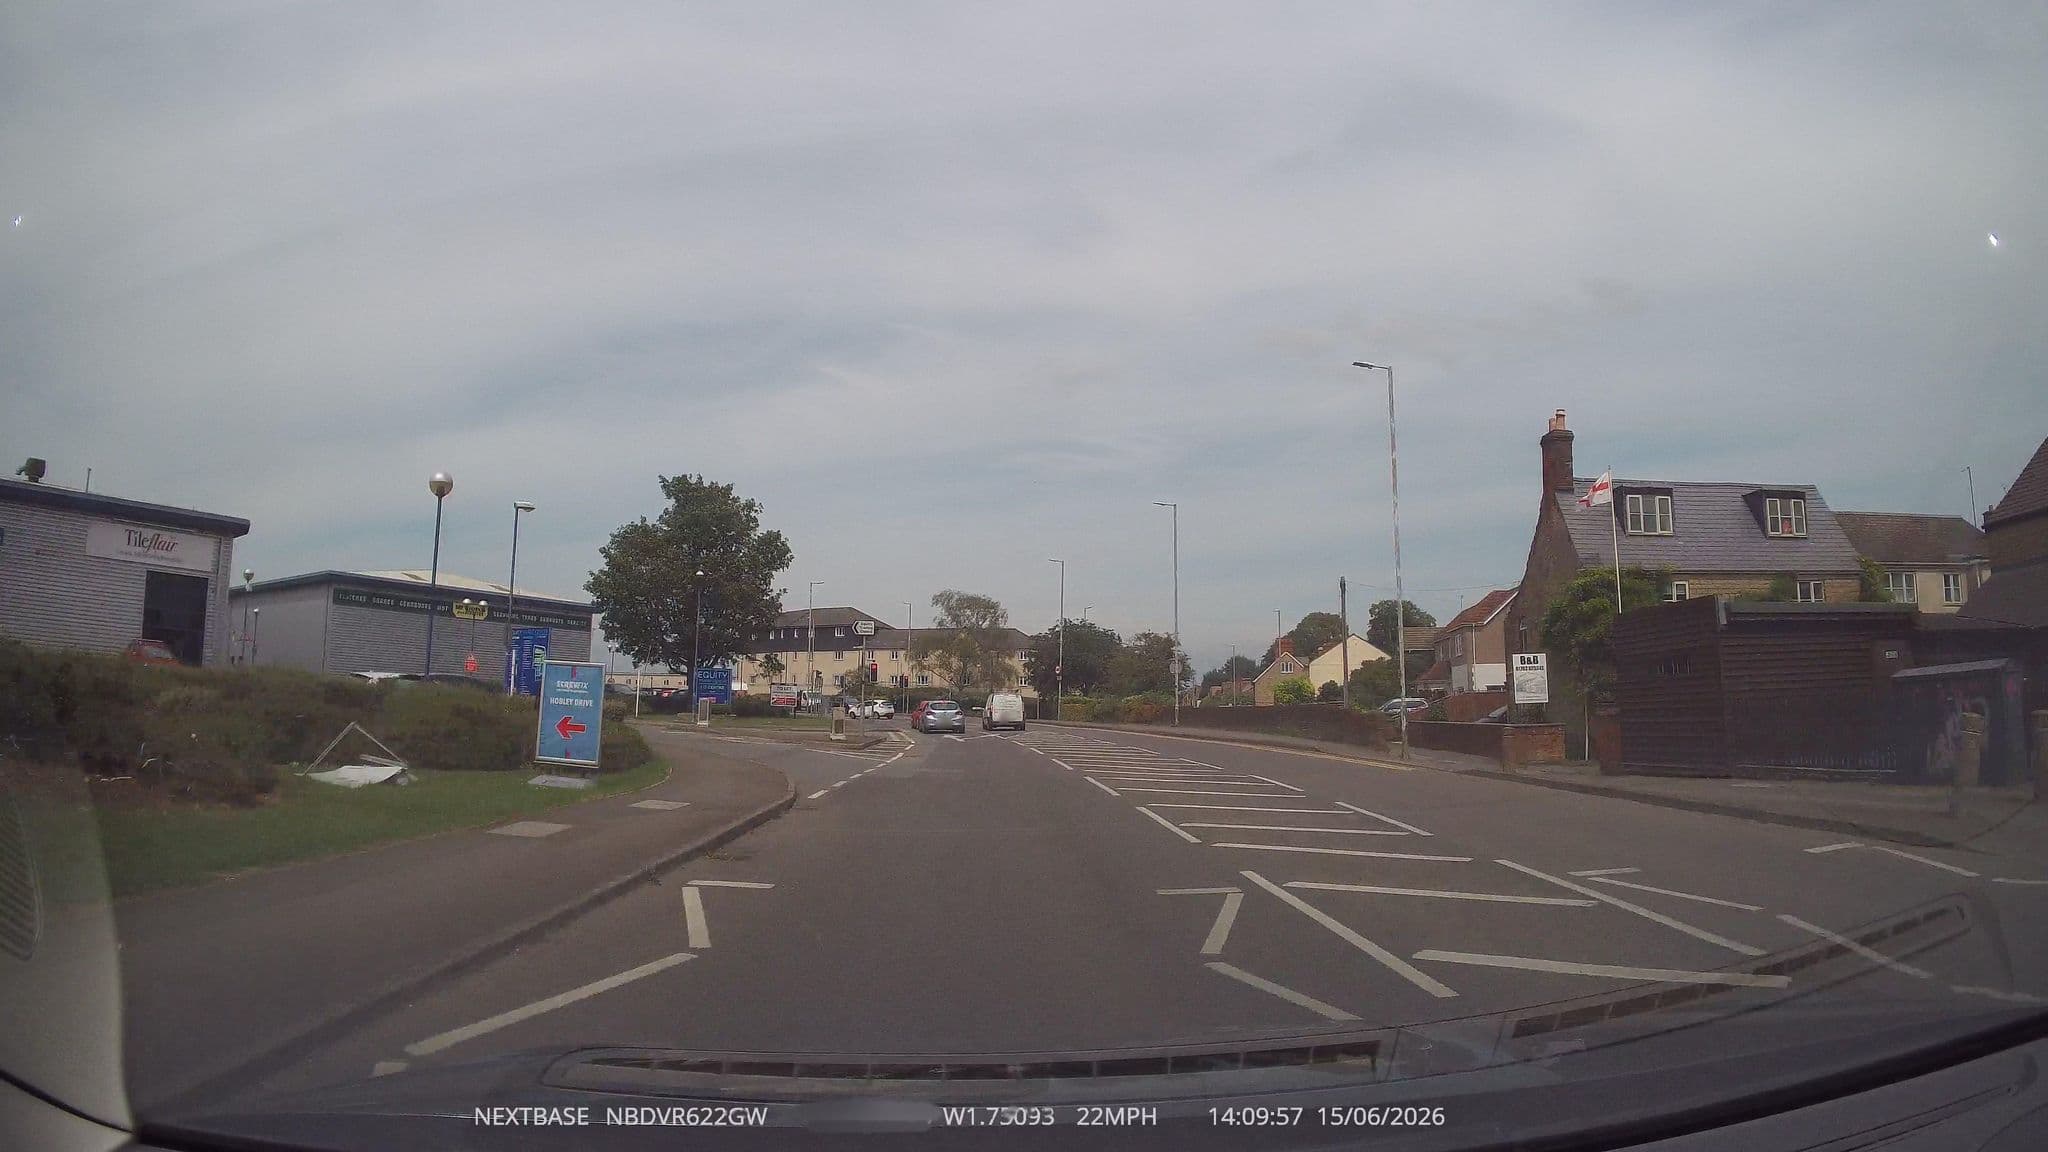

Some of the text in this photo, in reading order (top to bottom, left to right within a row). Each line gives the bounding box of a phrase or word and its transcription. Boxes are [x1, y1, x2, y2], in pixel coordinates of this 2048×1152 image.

[124, 528, 178, 552] Tileflair
[1520, 655, 1539, 665] B&B
[697, 670, 728, 679] EQUITY
[574, 699, 593, 708] DRIVE
